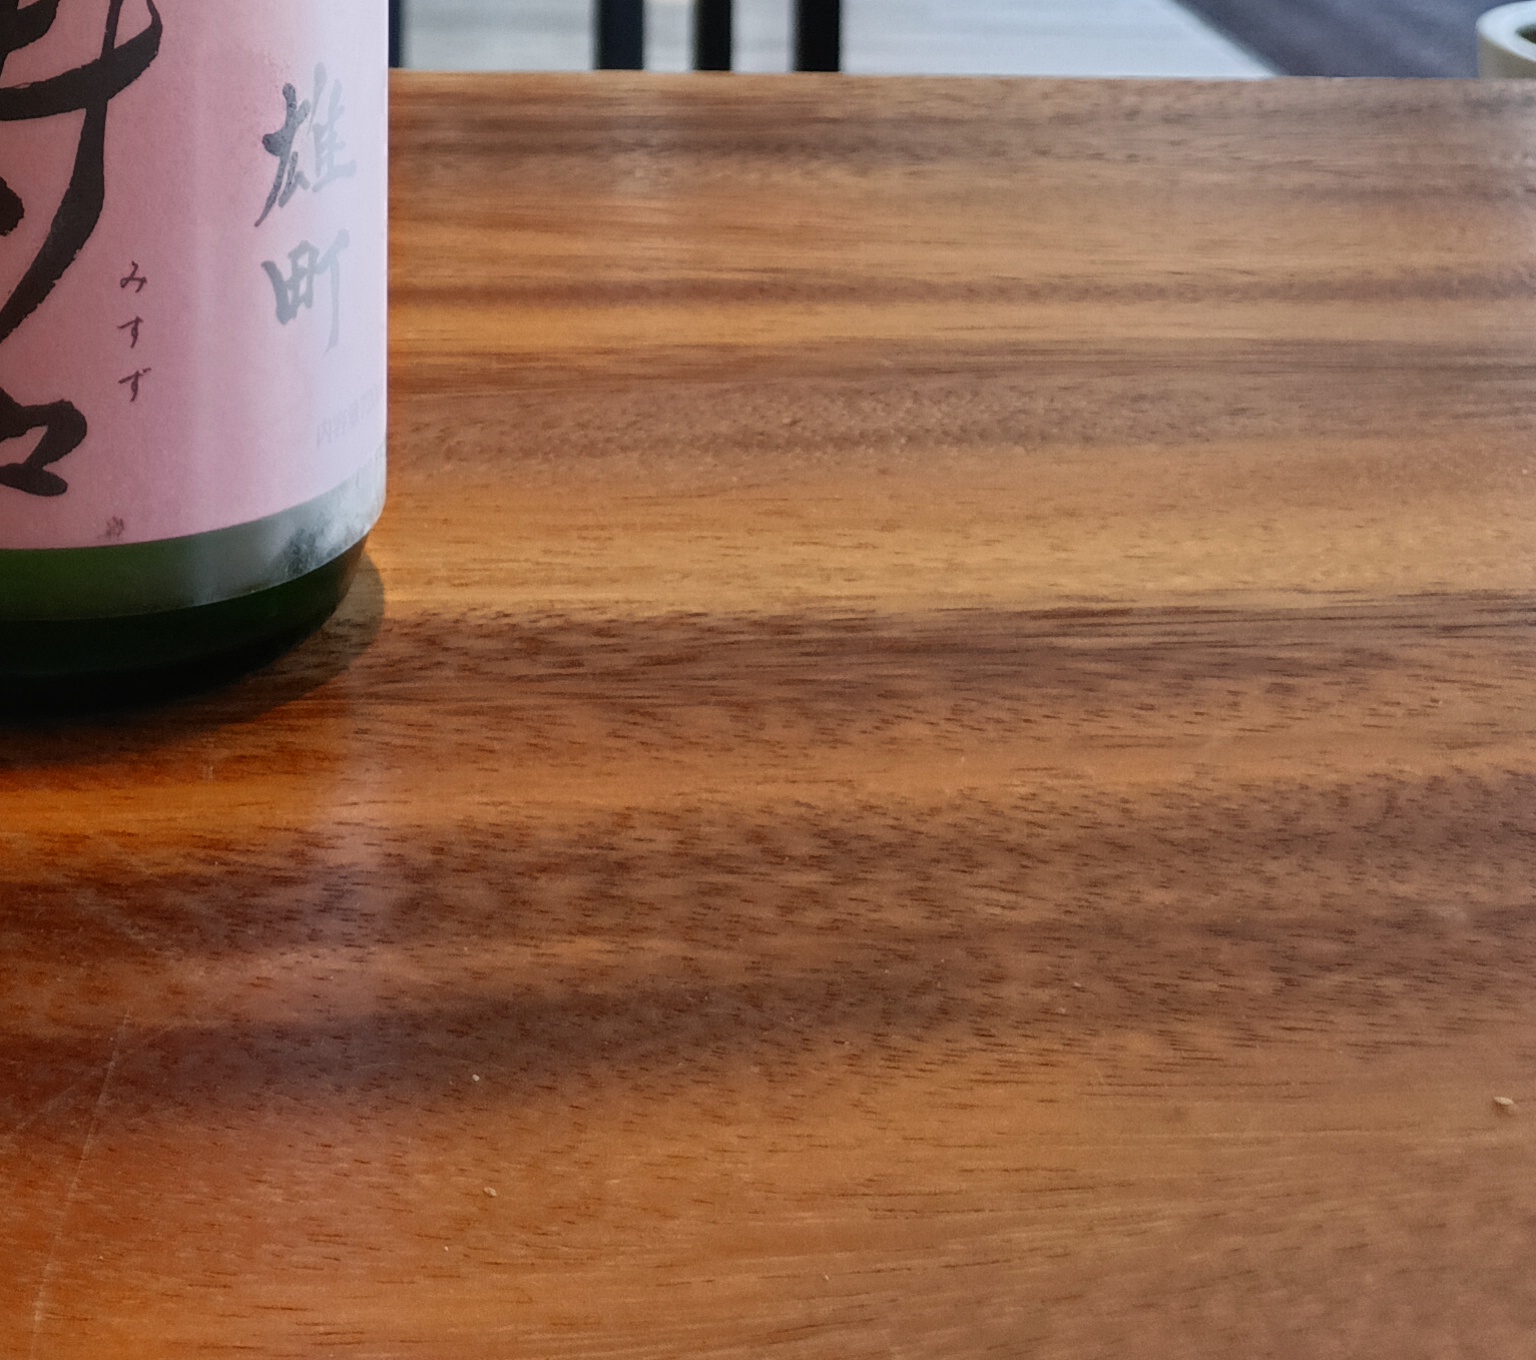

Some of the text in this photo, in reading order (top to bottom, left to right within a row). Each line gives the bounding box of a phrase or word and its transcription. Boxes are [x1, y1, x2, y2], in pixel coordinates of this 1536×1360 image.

[253, 62, 358, 356] 雄町
[116, 259, 153, 403] みすず
